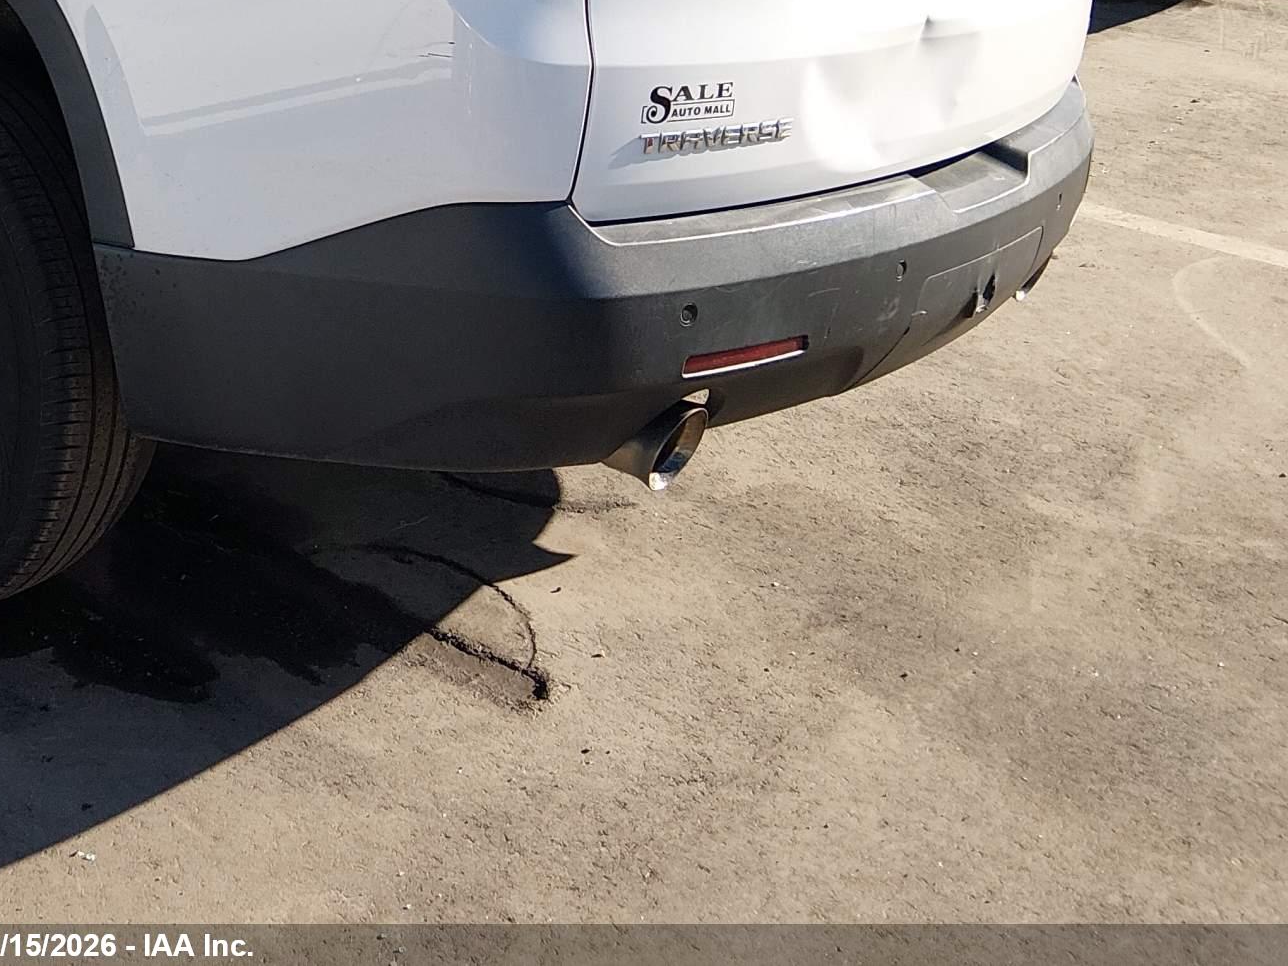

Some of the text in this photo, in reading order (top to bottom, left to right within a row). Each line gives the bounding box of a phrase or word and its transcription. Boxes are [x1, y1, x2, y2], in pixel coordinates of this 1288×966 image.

[646, 82, 733, 124] SALE
[671, 104, 731, 118] AUTO MALL
[640, 118, 794, 154] TRAVERSE
